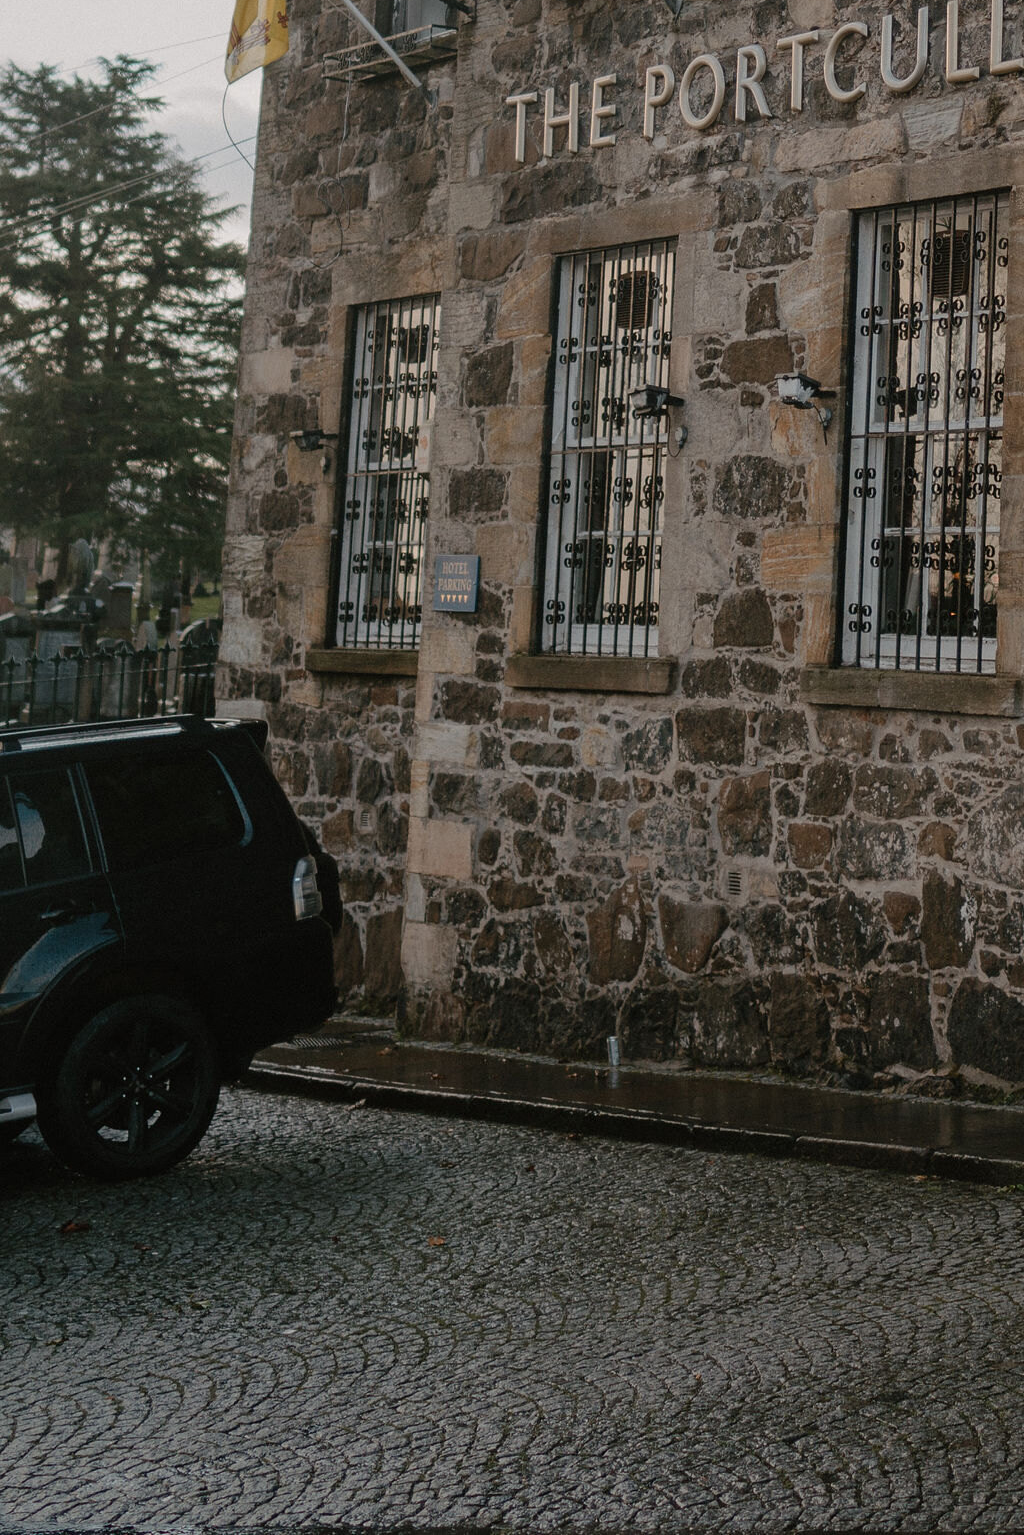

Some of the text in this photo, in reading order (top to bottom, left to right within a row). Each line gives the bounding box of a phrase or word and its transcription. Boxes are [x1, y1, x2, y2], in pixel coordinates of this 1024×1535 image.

[505, 72, 618, 163] THE
[442, 561, 469, 575] HOTEL
[438, 578, 472, 592] PARKING
